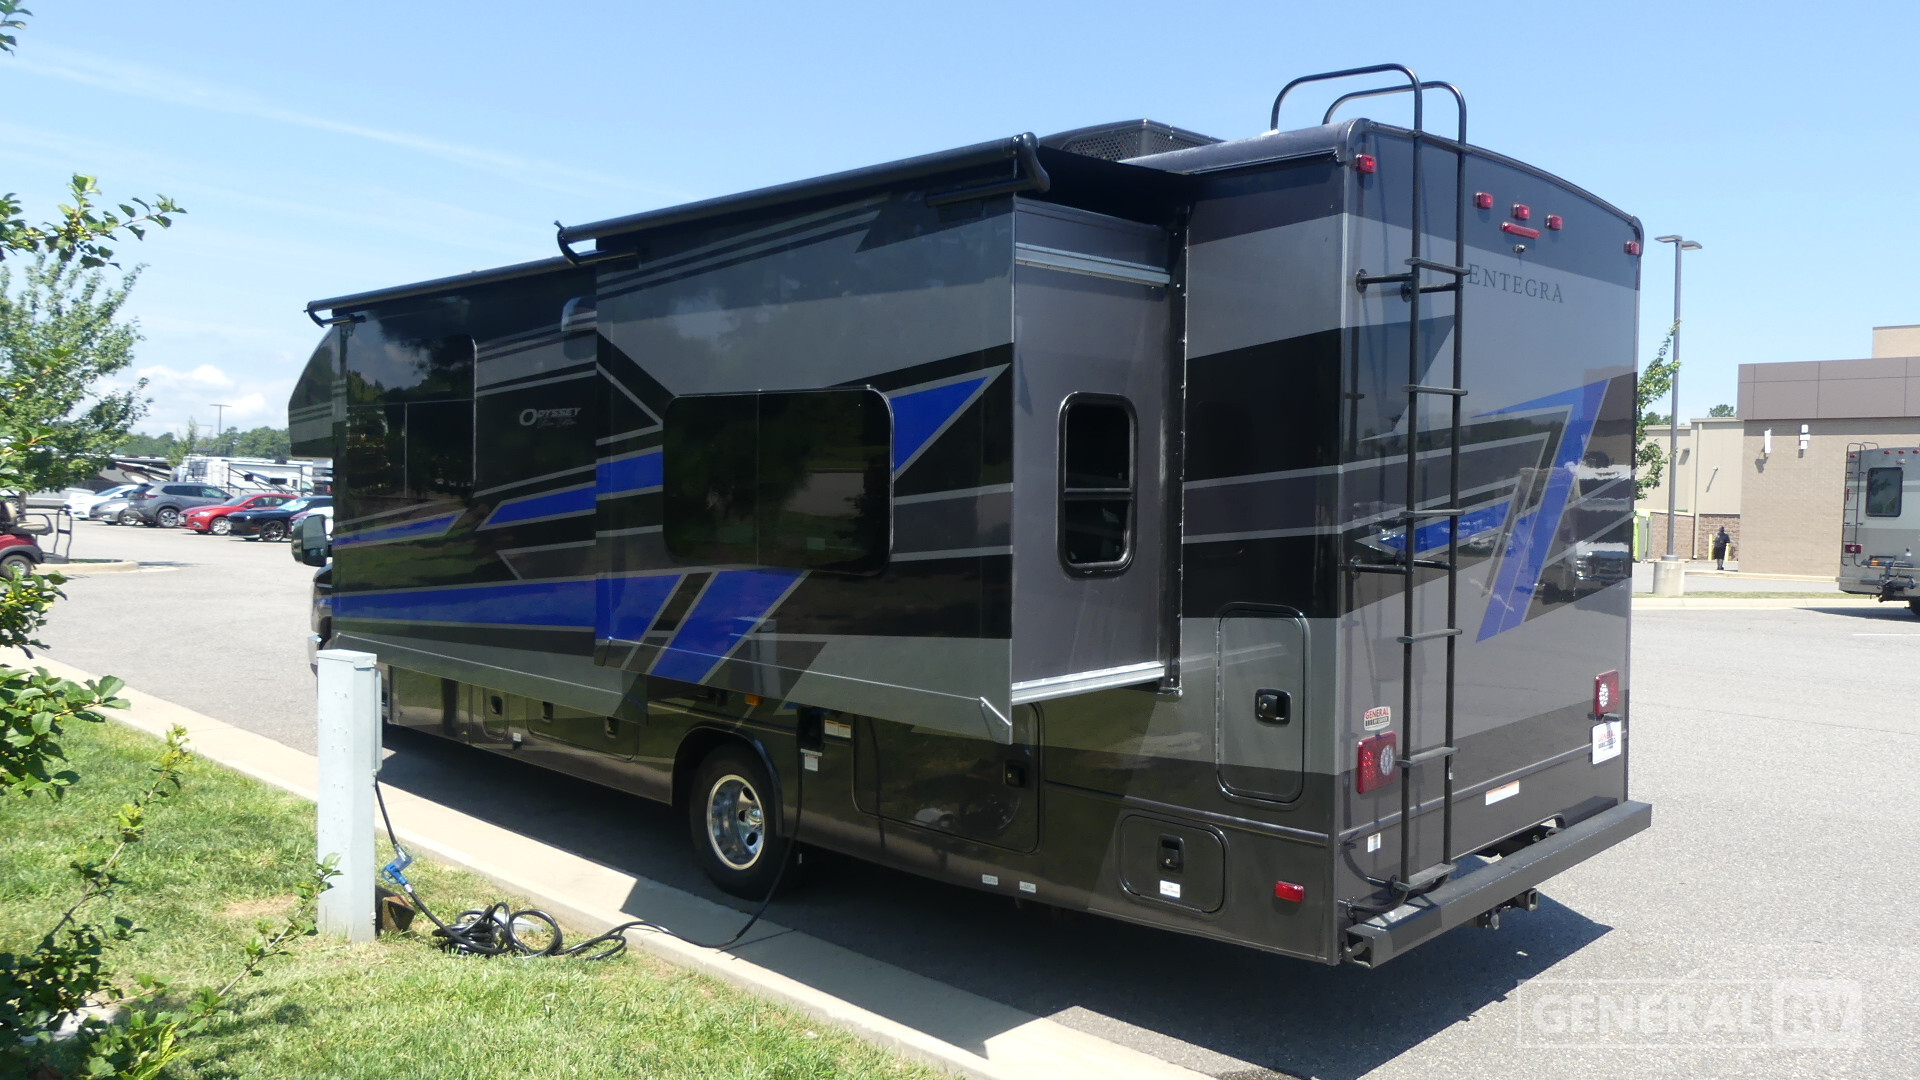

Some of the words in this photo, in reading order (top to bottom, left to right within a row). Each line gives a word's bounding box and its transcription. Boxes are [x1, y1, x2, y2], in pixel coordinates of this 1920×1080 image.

[1467, 263, 1564, 304] ENTEGRA
[519, 407, 582, 426] ODYSSEY
[1365, 707, 1390, 720] GENERAL
